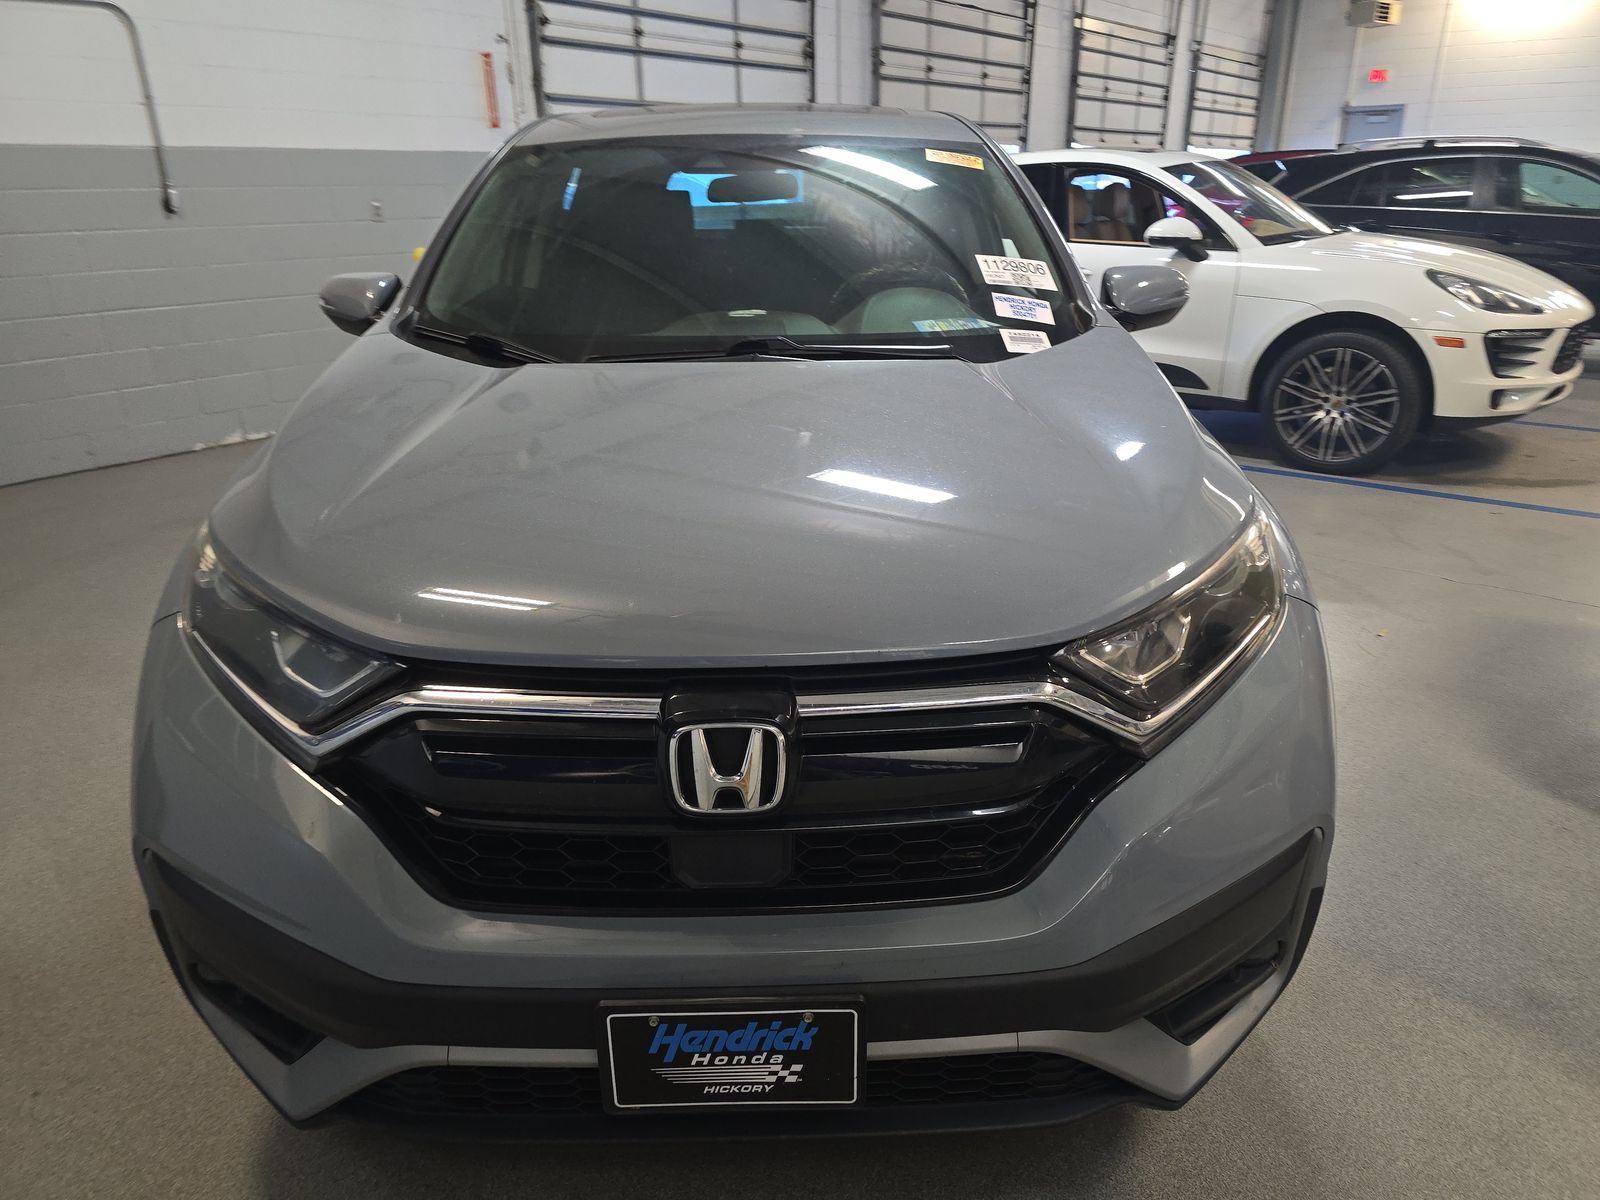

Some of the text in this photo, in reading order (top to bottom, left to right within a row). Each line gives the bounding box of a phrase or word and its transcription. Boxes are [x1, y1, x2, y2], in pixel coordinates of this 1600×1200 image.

[983, 259, 1046, 275] 1129806
[993, 295, 1049, 309] HENDRICK HONDA
[648, 1020, 819, 1063] Hendrick
[690, 1053, 784, 1066] Honda
[703, 1084, 775, 1094] HICKORY
